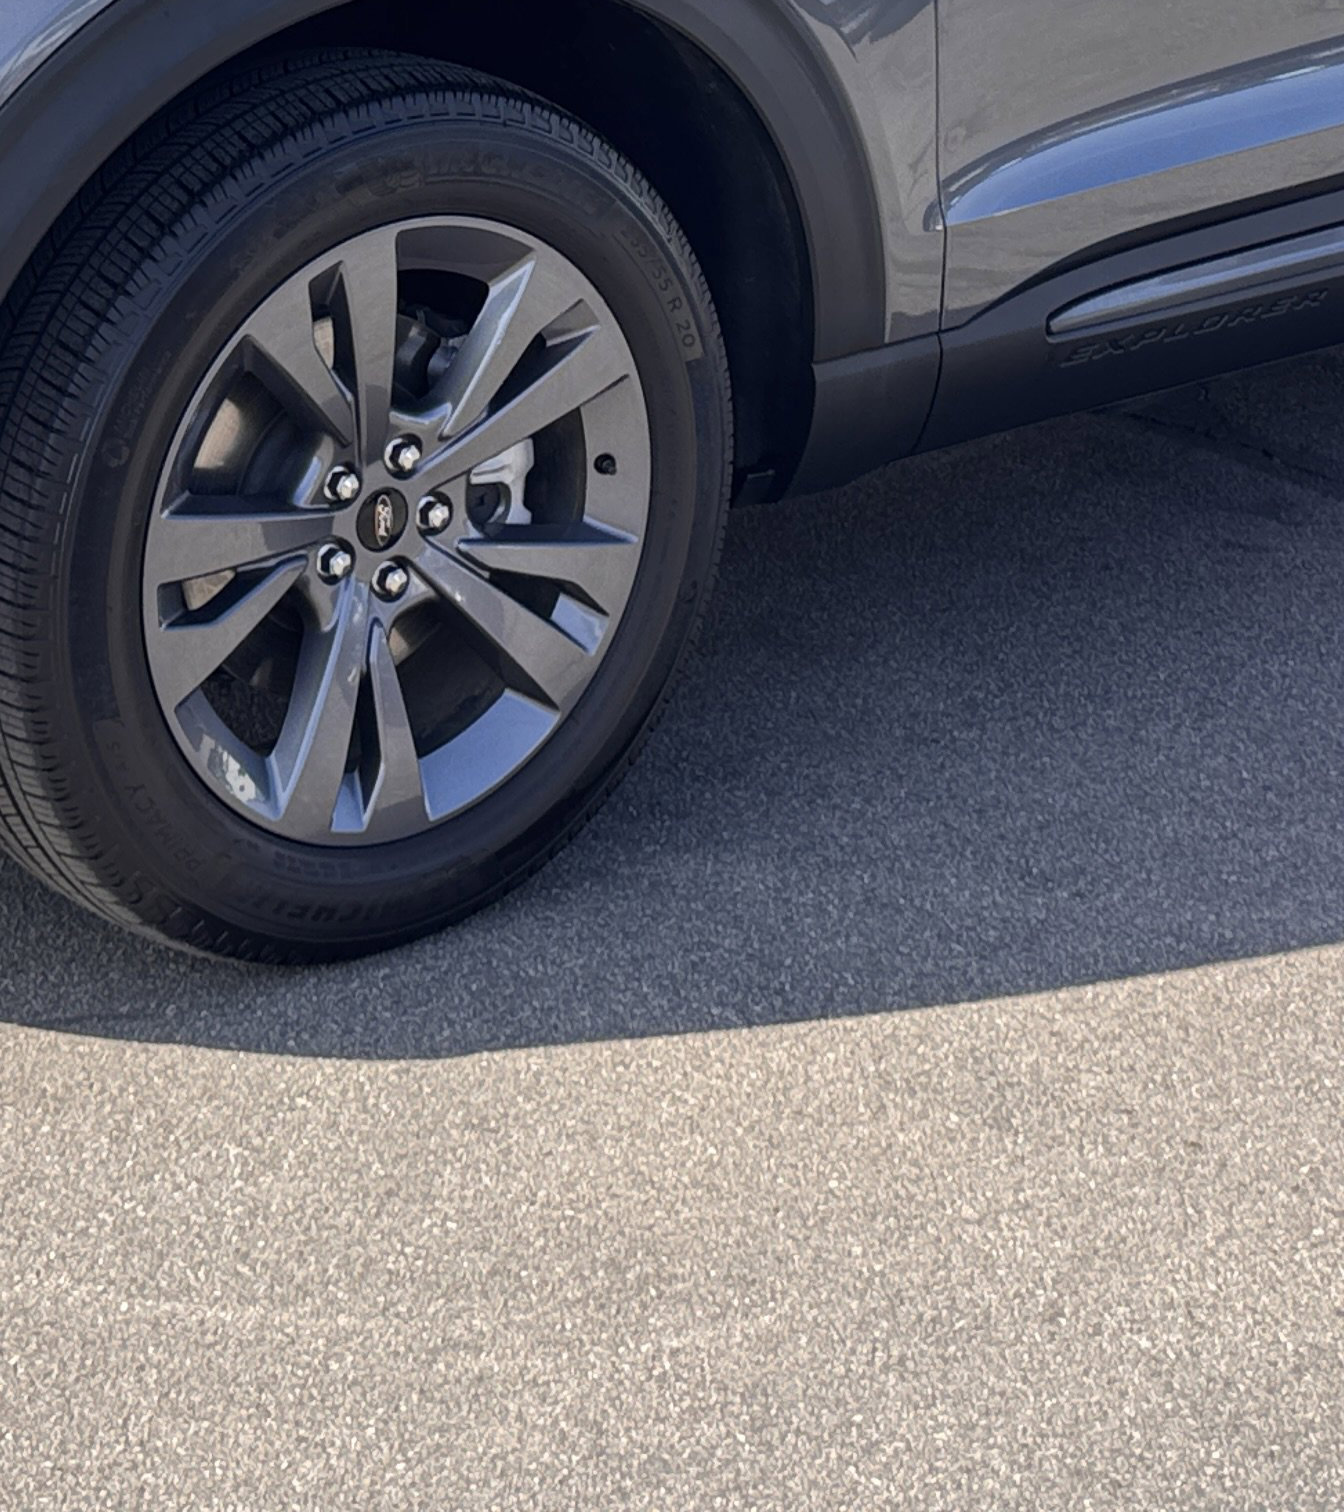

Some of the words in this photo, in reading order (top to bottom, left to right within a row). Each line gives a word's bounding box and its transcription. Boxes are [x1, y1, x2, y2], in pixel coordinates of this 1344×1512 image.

[666, 297, 683, 312] R
[674, 320, 697, 348] 20
[1059, 290, 1328, 368] EXPLORER
